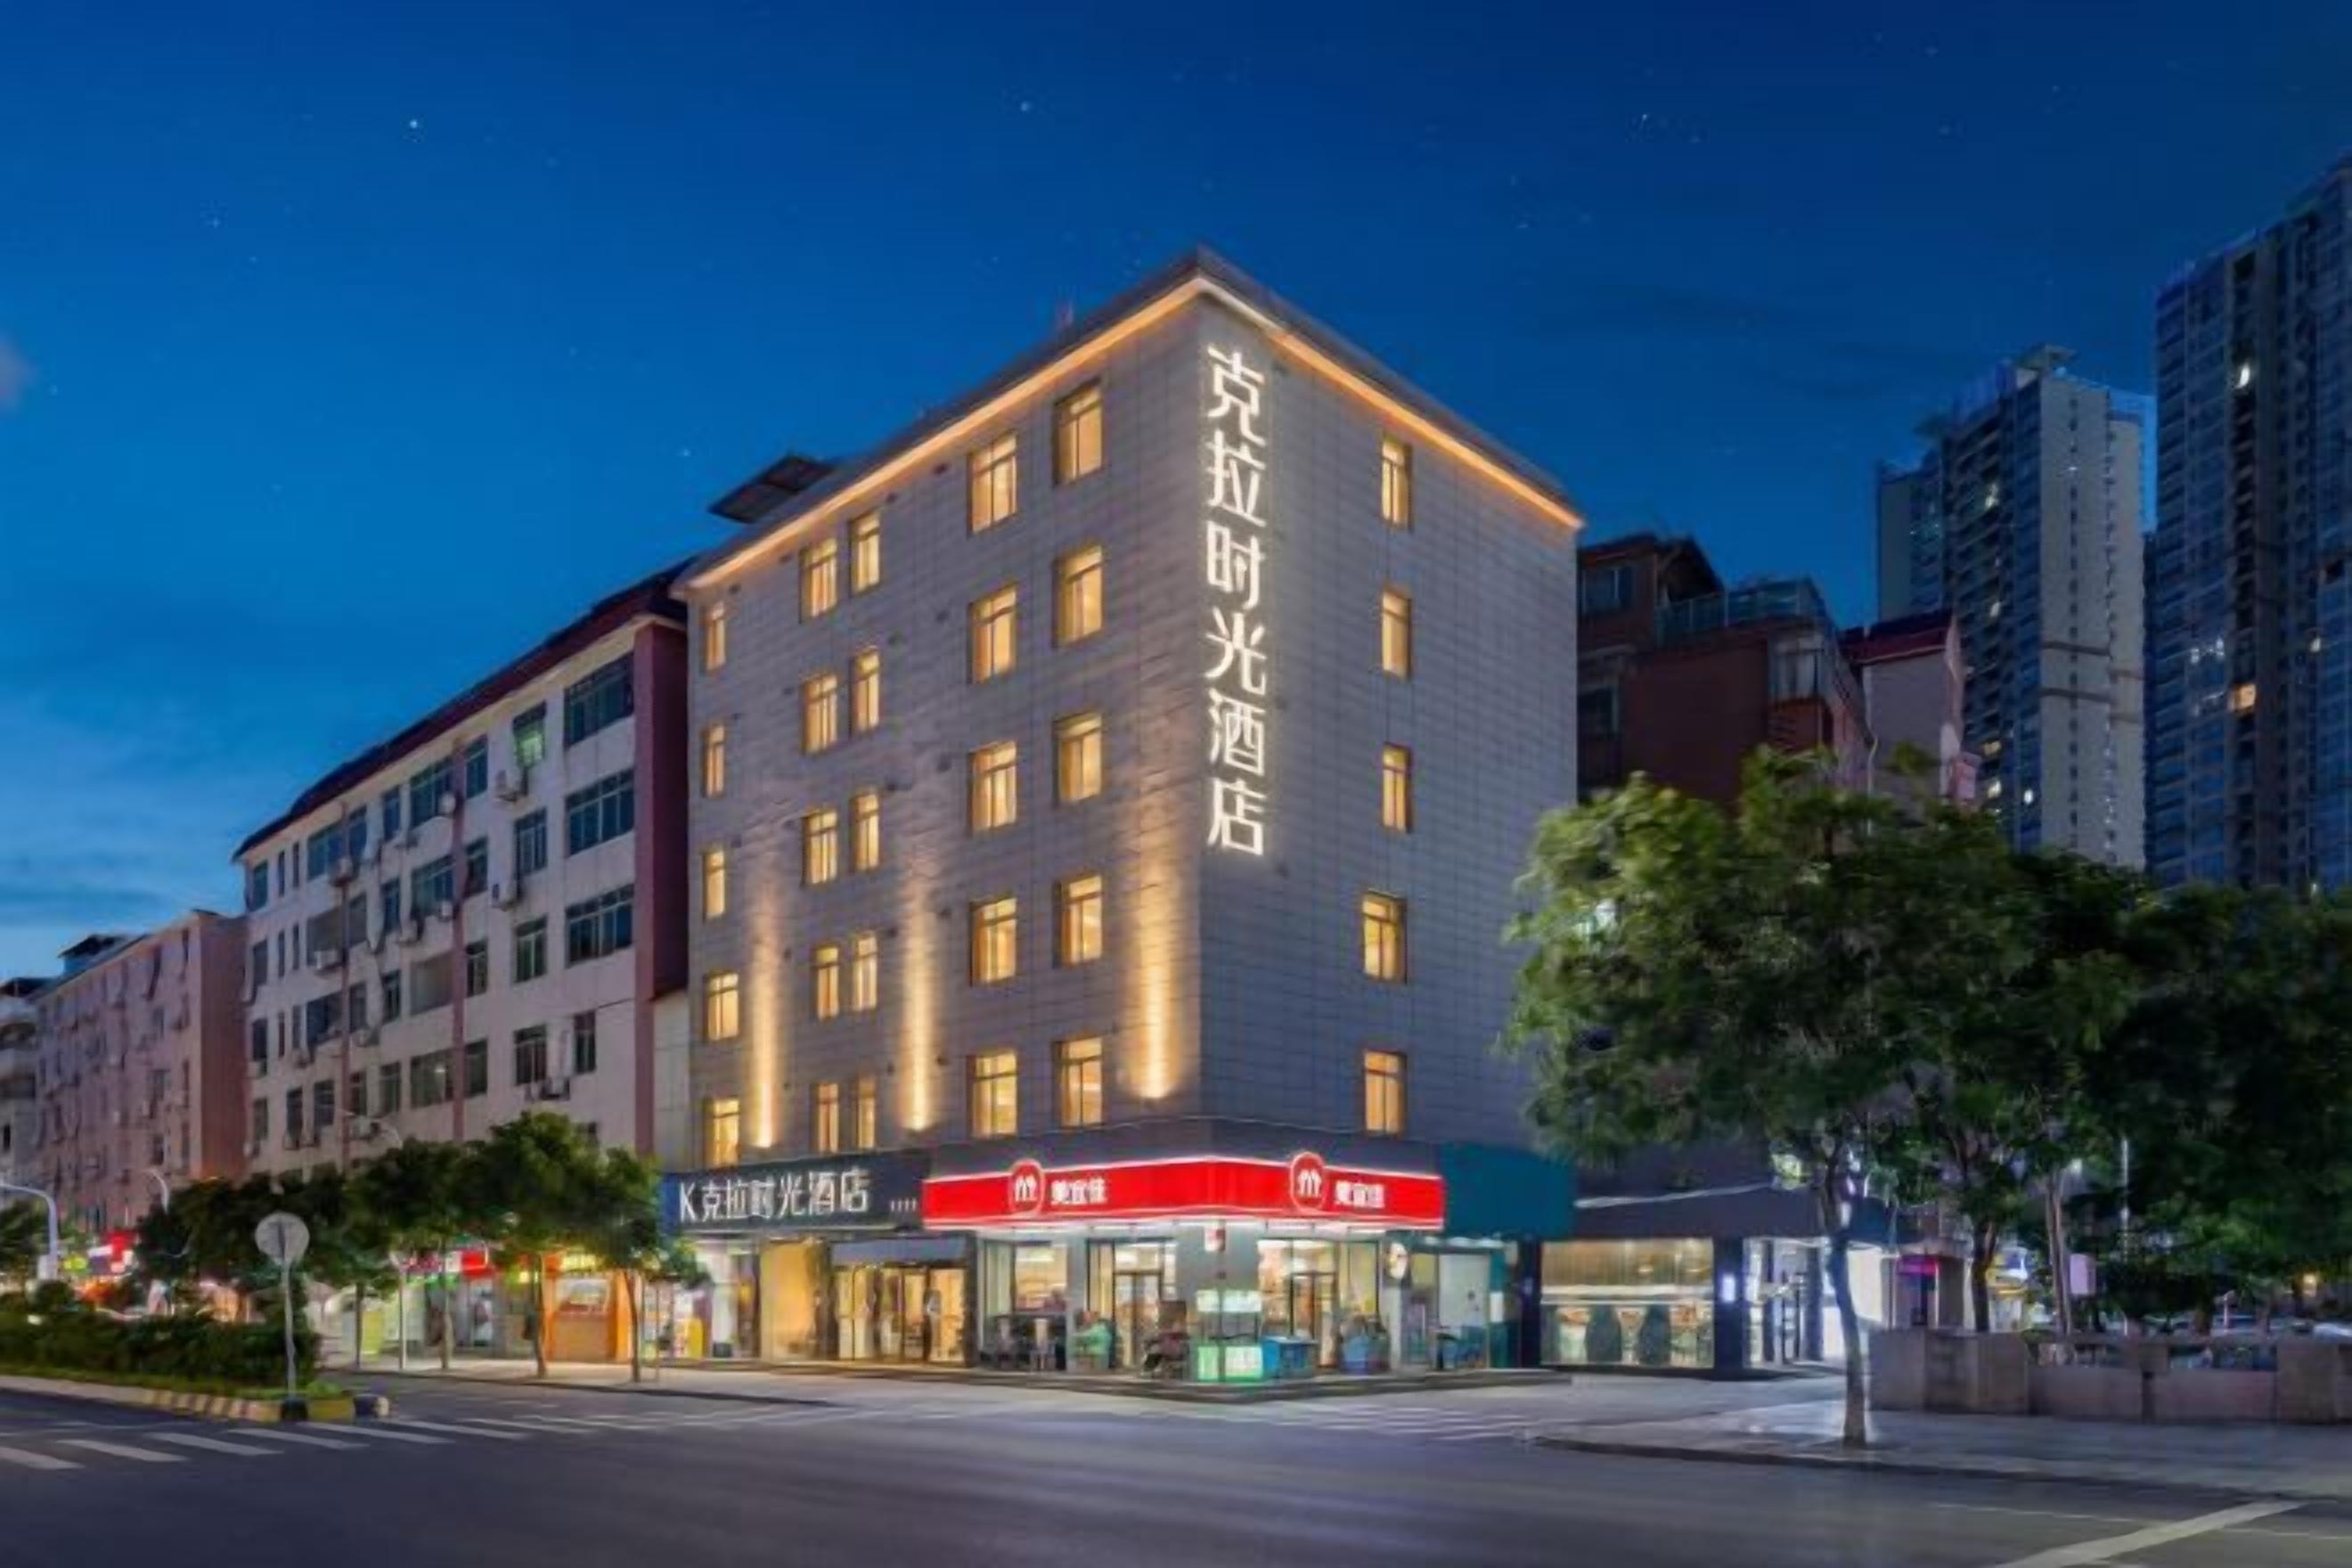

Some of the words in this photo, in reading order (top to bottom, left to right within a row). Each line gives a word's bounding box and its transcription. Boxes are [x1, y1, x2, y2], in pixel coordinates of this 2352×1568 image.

[1205, 343, 1266, 856] 克拉时光酒店
